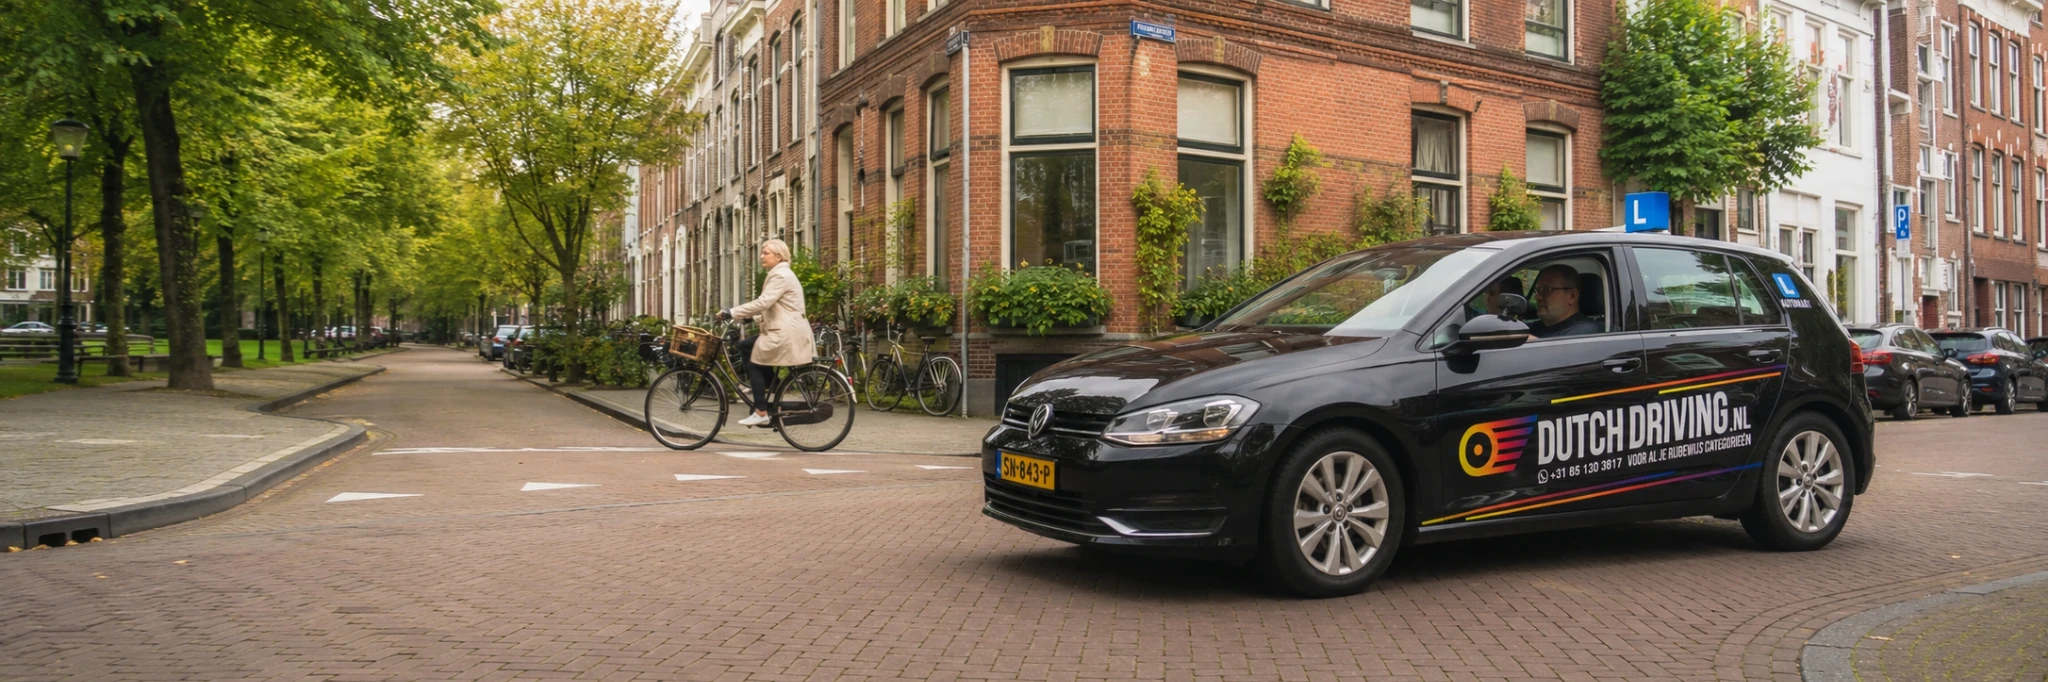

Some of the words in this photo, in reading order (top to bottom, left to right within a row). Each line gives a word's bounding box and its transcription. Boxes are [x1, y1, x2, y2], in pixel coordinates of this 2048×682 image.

[1633, 199, 1647, 225] L
[1897, 208, 1907, 228] P
[1777, 276, 1796, 295] L
[1537, 407, 1624, 466] DUTCH
[1627, 451, 1647, 467] VOOR
[1648, 450, 1658, 463] AL
[1658, 448, 1668, 462] JE
[1550, 467, 1567, 480] +31
[1583, 461, 1599, 475] 130
[1601, 457, 1623, 471] 3817
